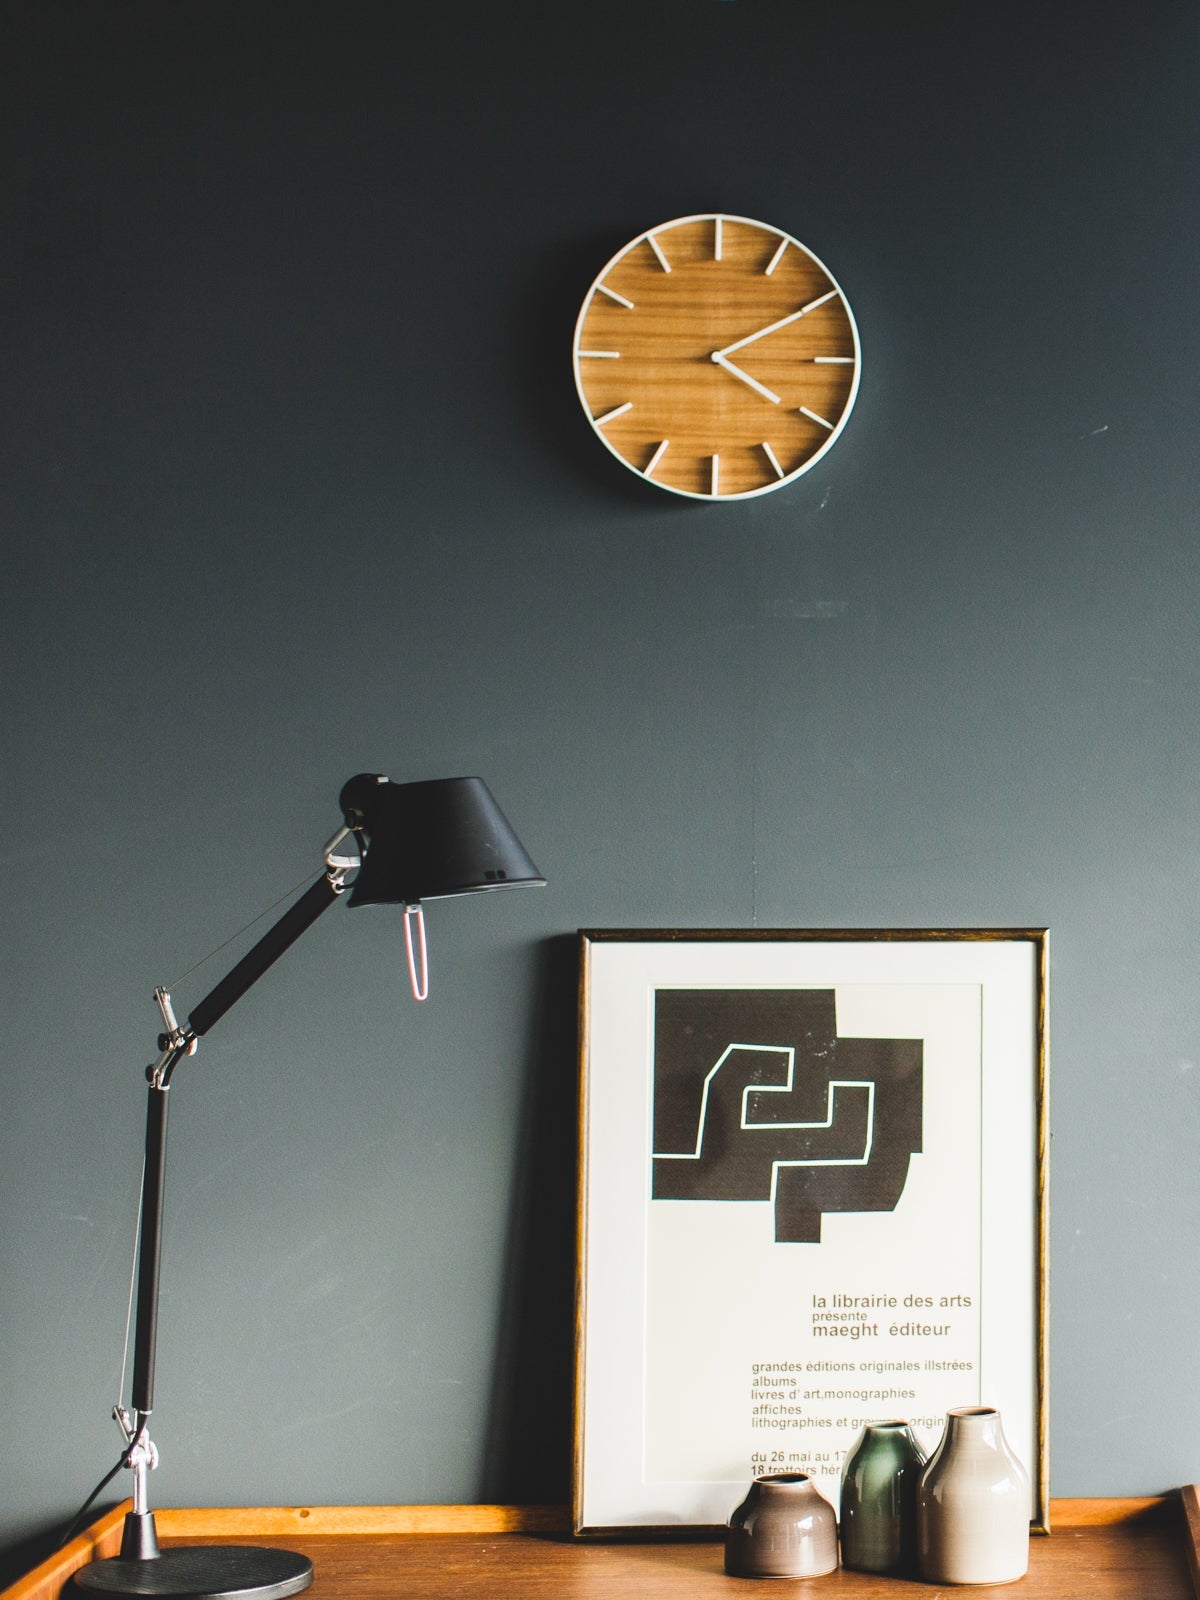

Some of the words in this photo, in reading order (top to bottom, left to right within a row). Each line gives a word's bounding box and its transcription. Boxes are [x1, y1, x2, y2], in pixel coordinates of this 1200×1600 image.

[812, 1293, 827, 1309] la
[832, 1293, 898, 1309] librairie
[903, 1293, 934, 1308] des
[939, 1294, 972, 1308] arts
[812, 1311, 868, 1324] présente
[812, 1322, 879, 1341] maeght
[888, 1322, 951, 1337] éditeur
[751, 1360, 803, 1376] grandes
[805, 1360, 856, 1372] éditions
[859, 1360, 921, 1375] originales
[752, 1375, 797, 1387] albums
[751, 1389, 785, 1400] livres
[752, 1403, 802, 1416] affiches
[751, 1416, 833, 1431] lithographies
[836, 1417, 848, 1428] et
[911, 1416, 944, 1428] origin
[750, 1451, 767, 1463] du
[770, 1450, 785, 1463] 26
[788, 1451, 811, 1462] mai
[814, 1453, 830, 1462] au
[751, 1465, 765, 1475] 18
